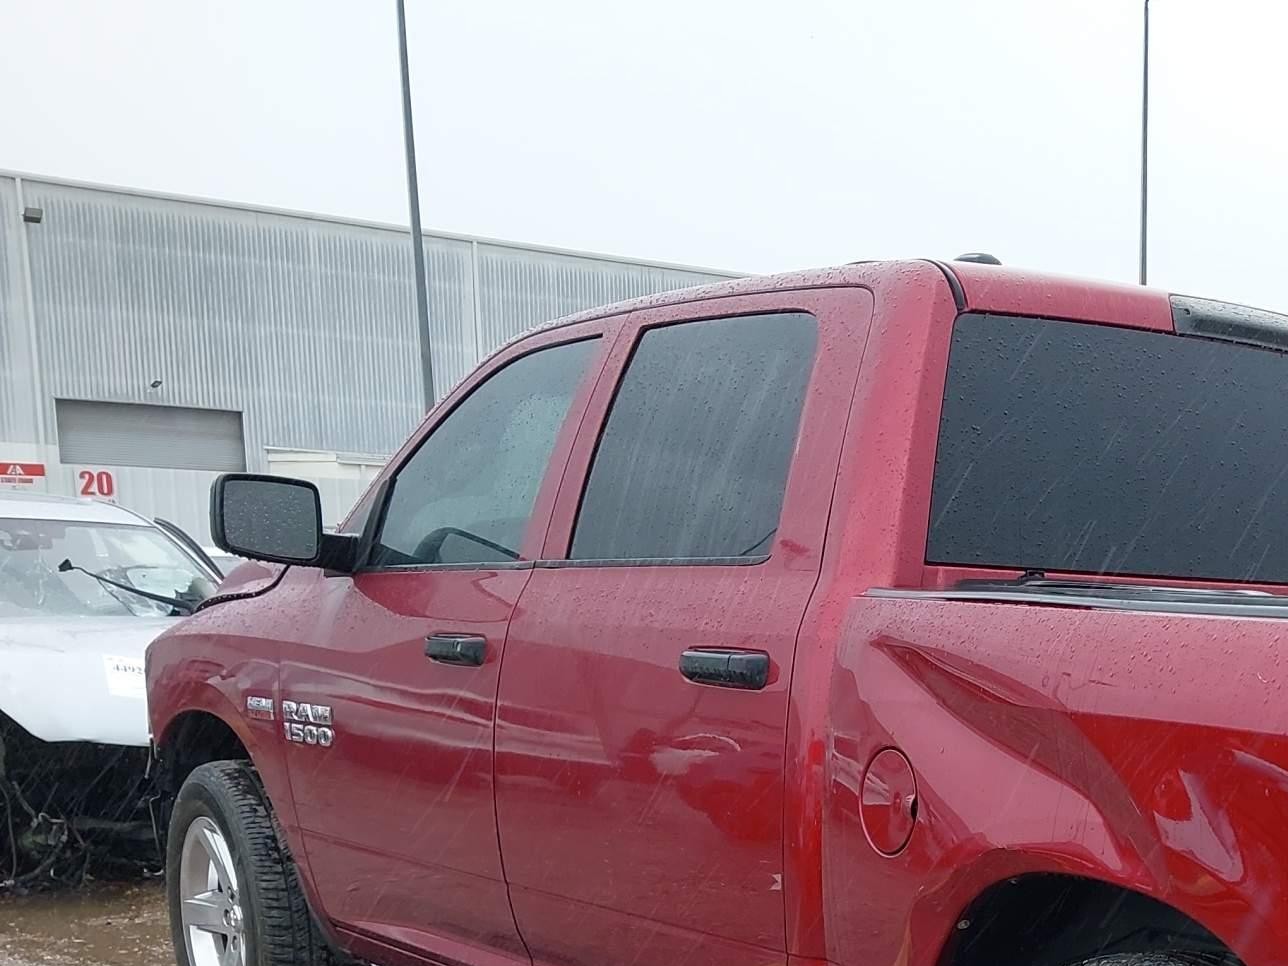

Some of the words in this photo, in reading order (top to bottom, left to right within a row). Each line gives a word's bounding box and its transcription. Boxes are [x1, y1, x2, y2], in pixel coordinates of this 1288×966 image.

[79, 470, 113, 496] 20
[282, 700, 332, 725] RAM
[283, 722, 334, 747] 1500
